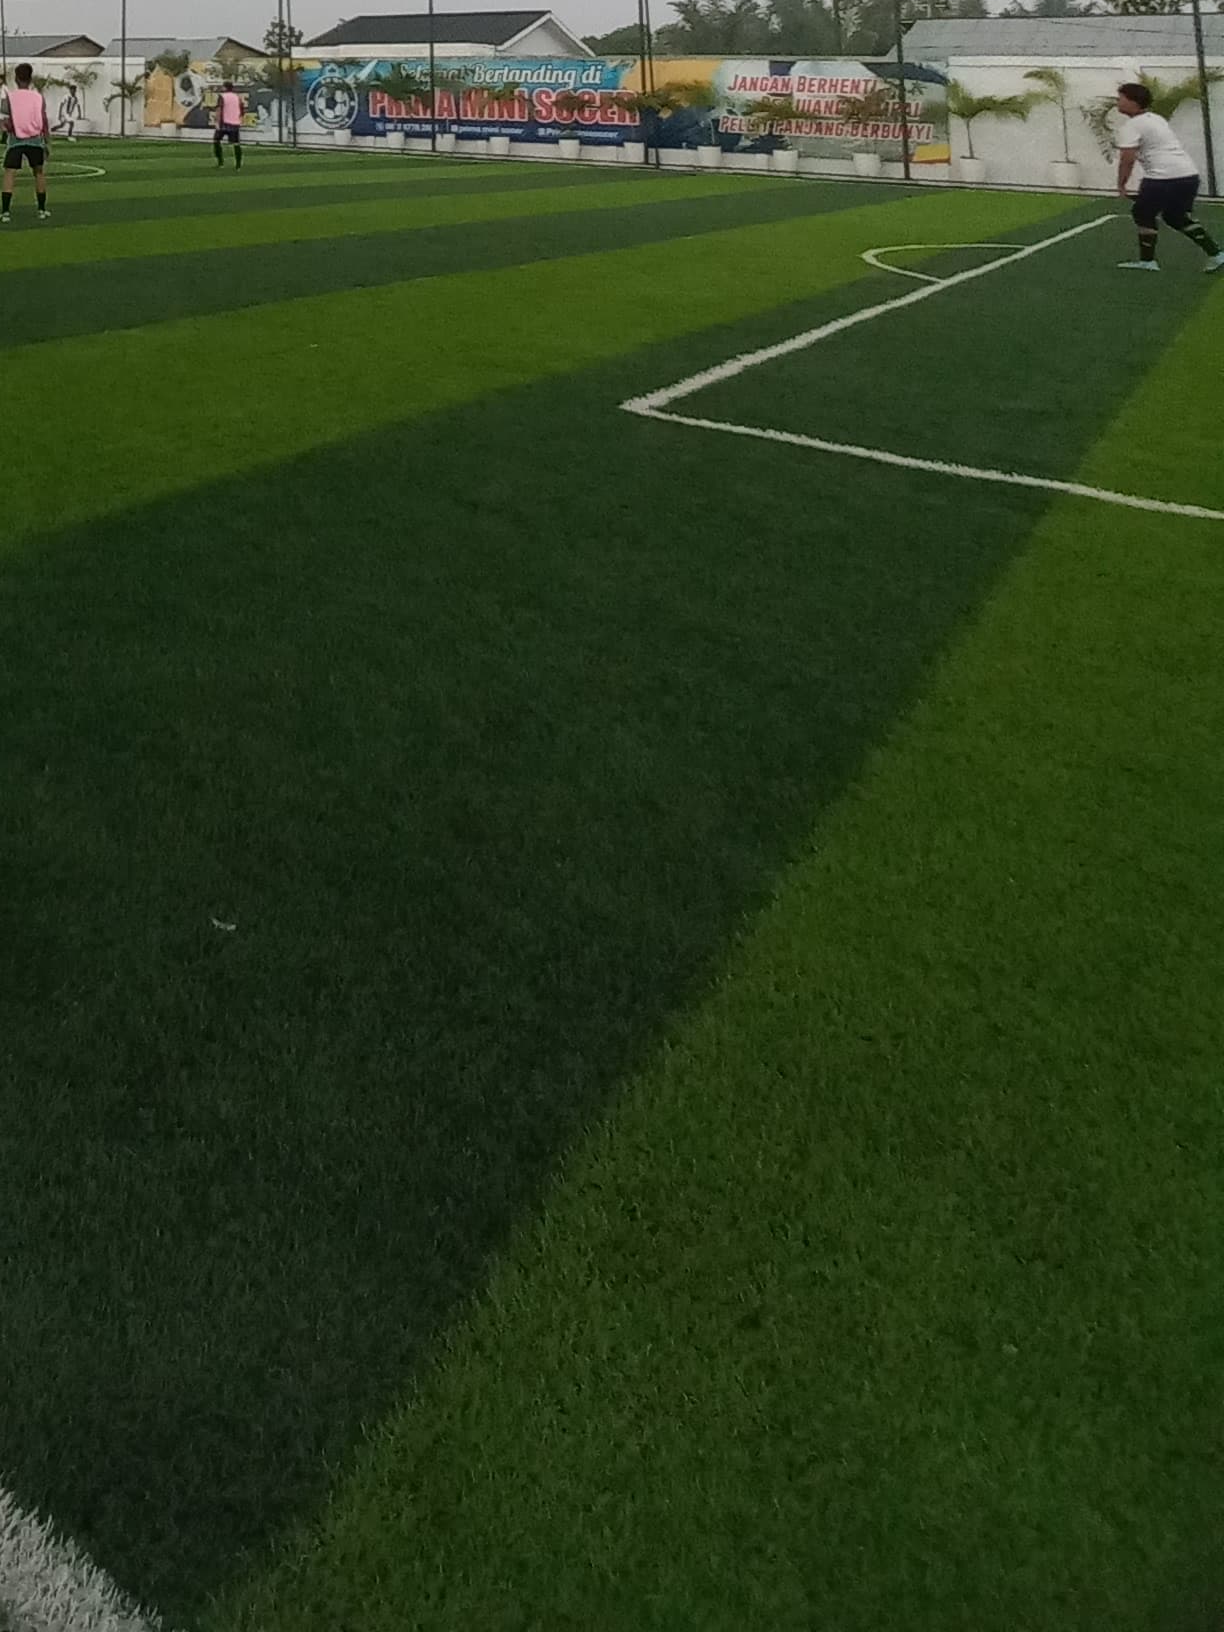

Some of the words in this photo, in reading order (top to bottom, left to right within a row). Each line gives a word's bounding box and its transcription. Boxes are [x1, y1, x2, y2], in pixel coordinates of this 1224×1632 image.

[581, 65, 601, 83] di
[727, 74, 793, 92] JANGAN
[796, 76, 877, 94] BERHENTI
[772, 118, 844, 137] PANJANG
